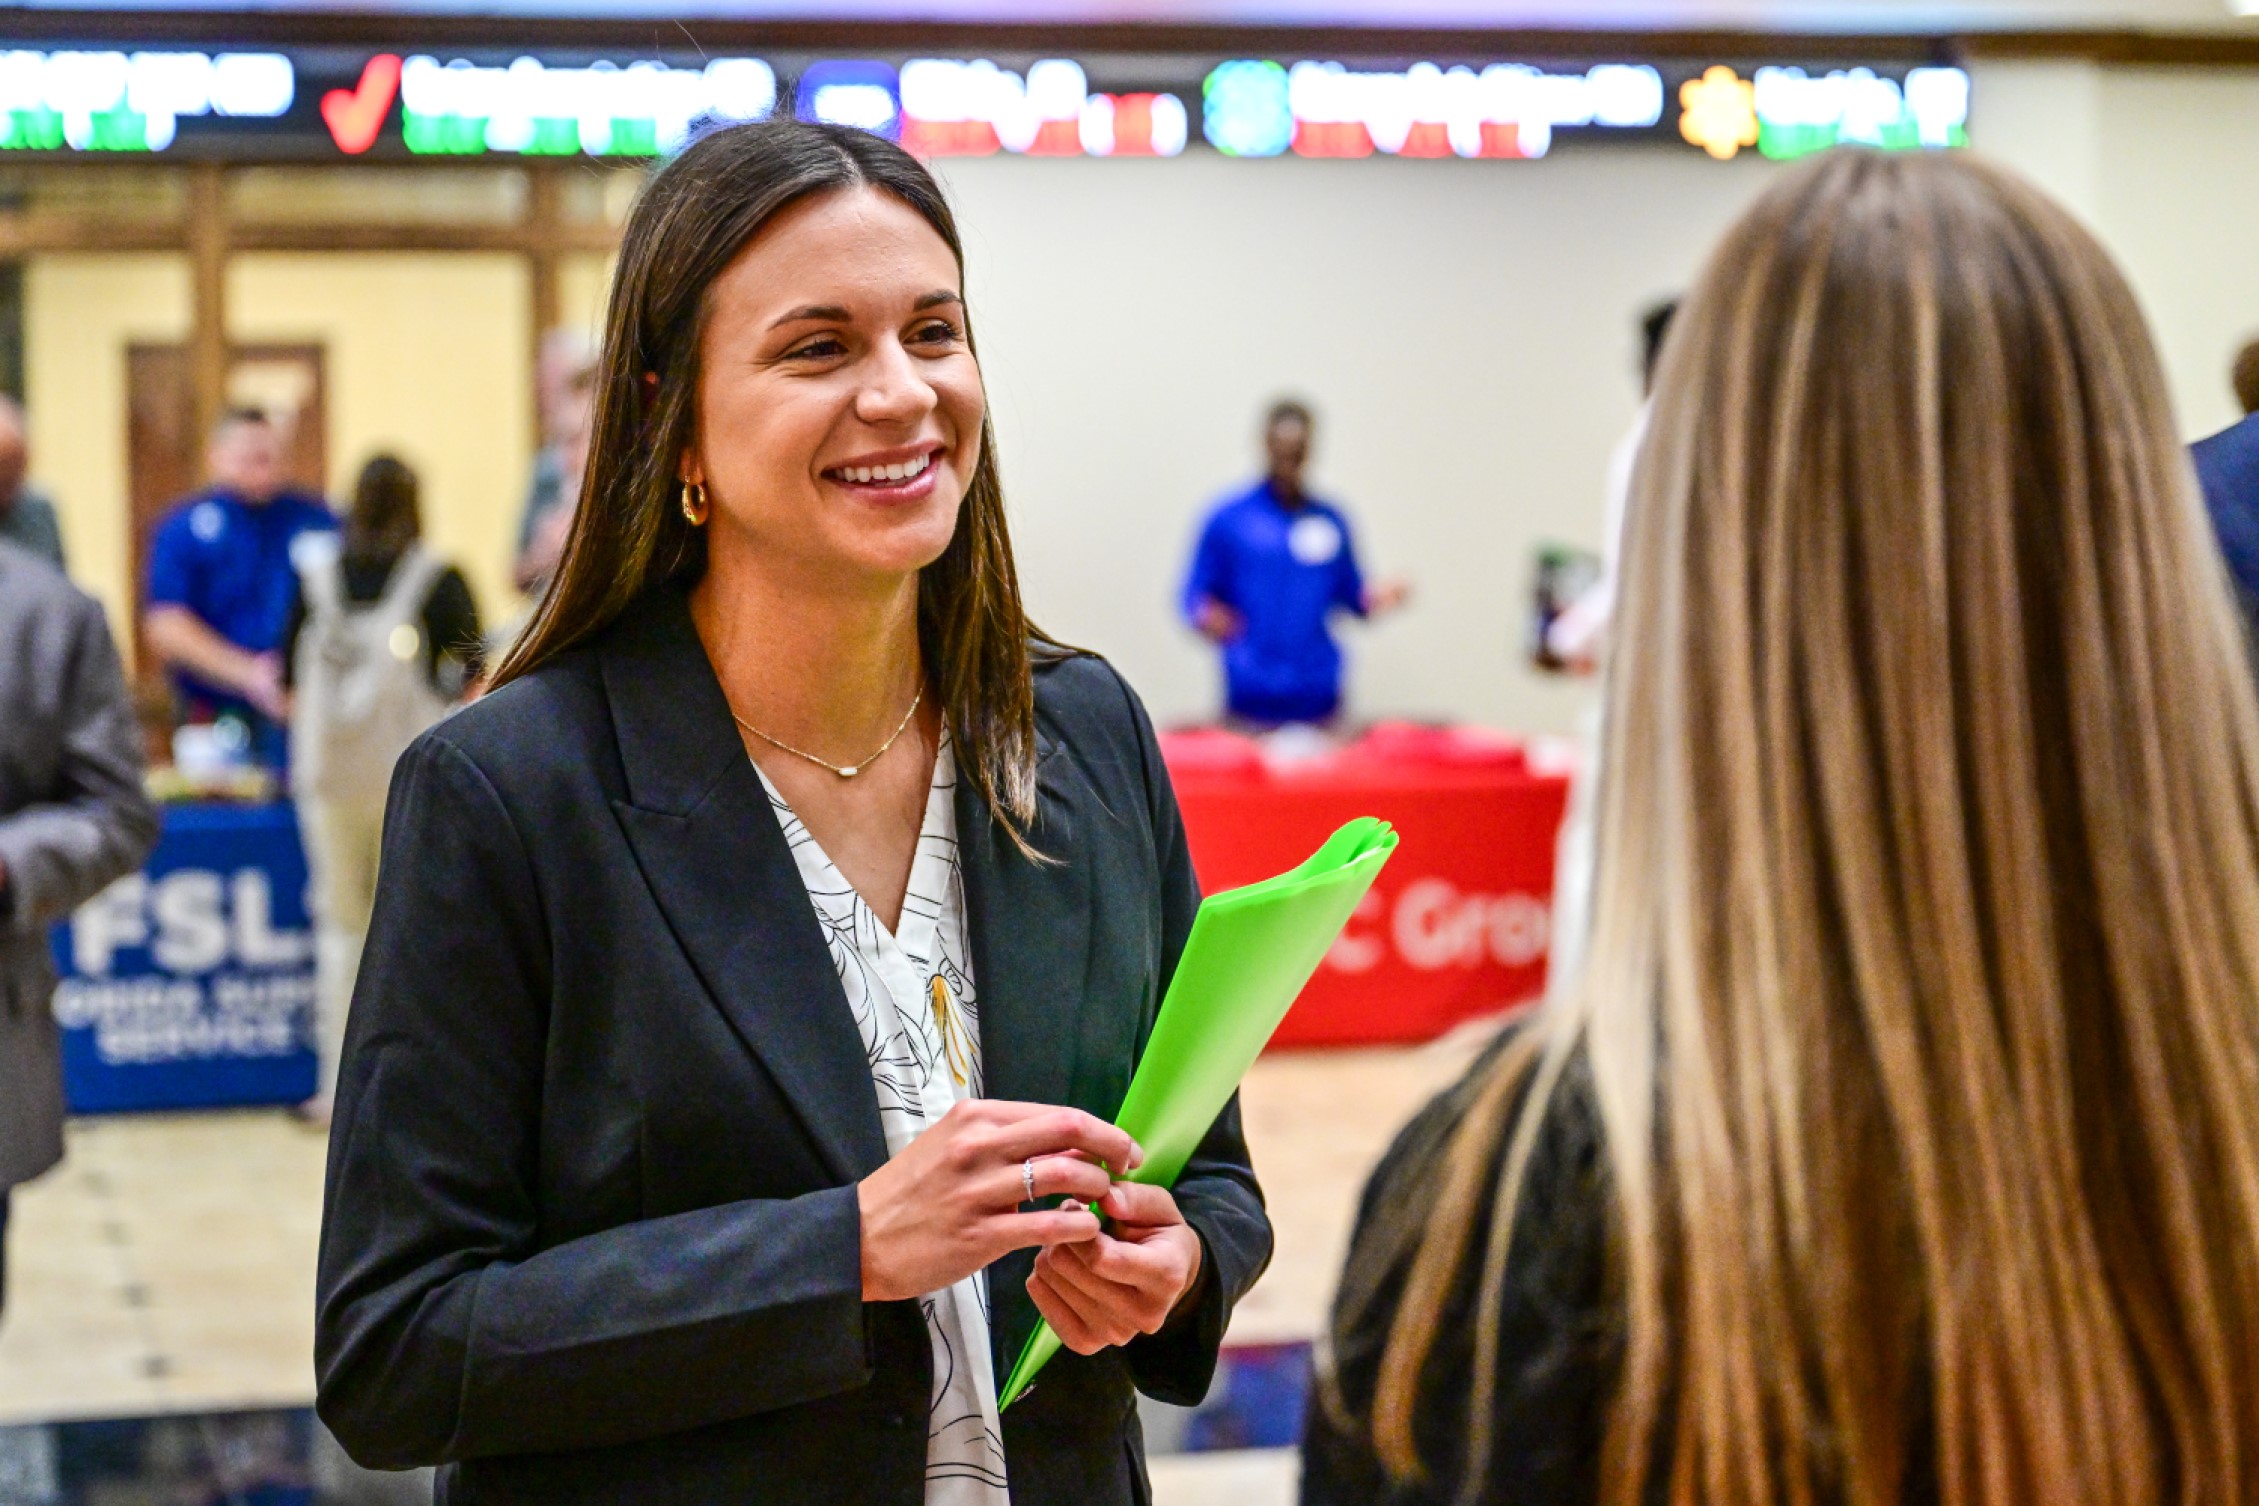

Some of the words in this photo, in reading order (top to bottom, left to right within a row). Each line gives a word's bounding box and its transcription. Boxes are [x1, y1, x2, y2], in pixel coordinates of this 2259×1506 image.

[70, 866, 311, 977] FSL
[1325, 884, 1384, 973] C
[1392, 878, 1550, 970] Gro
